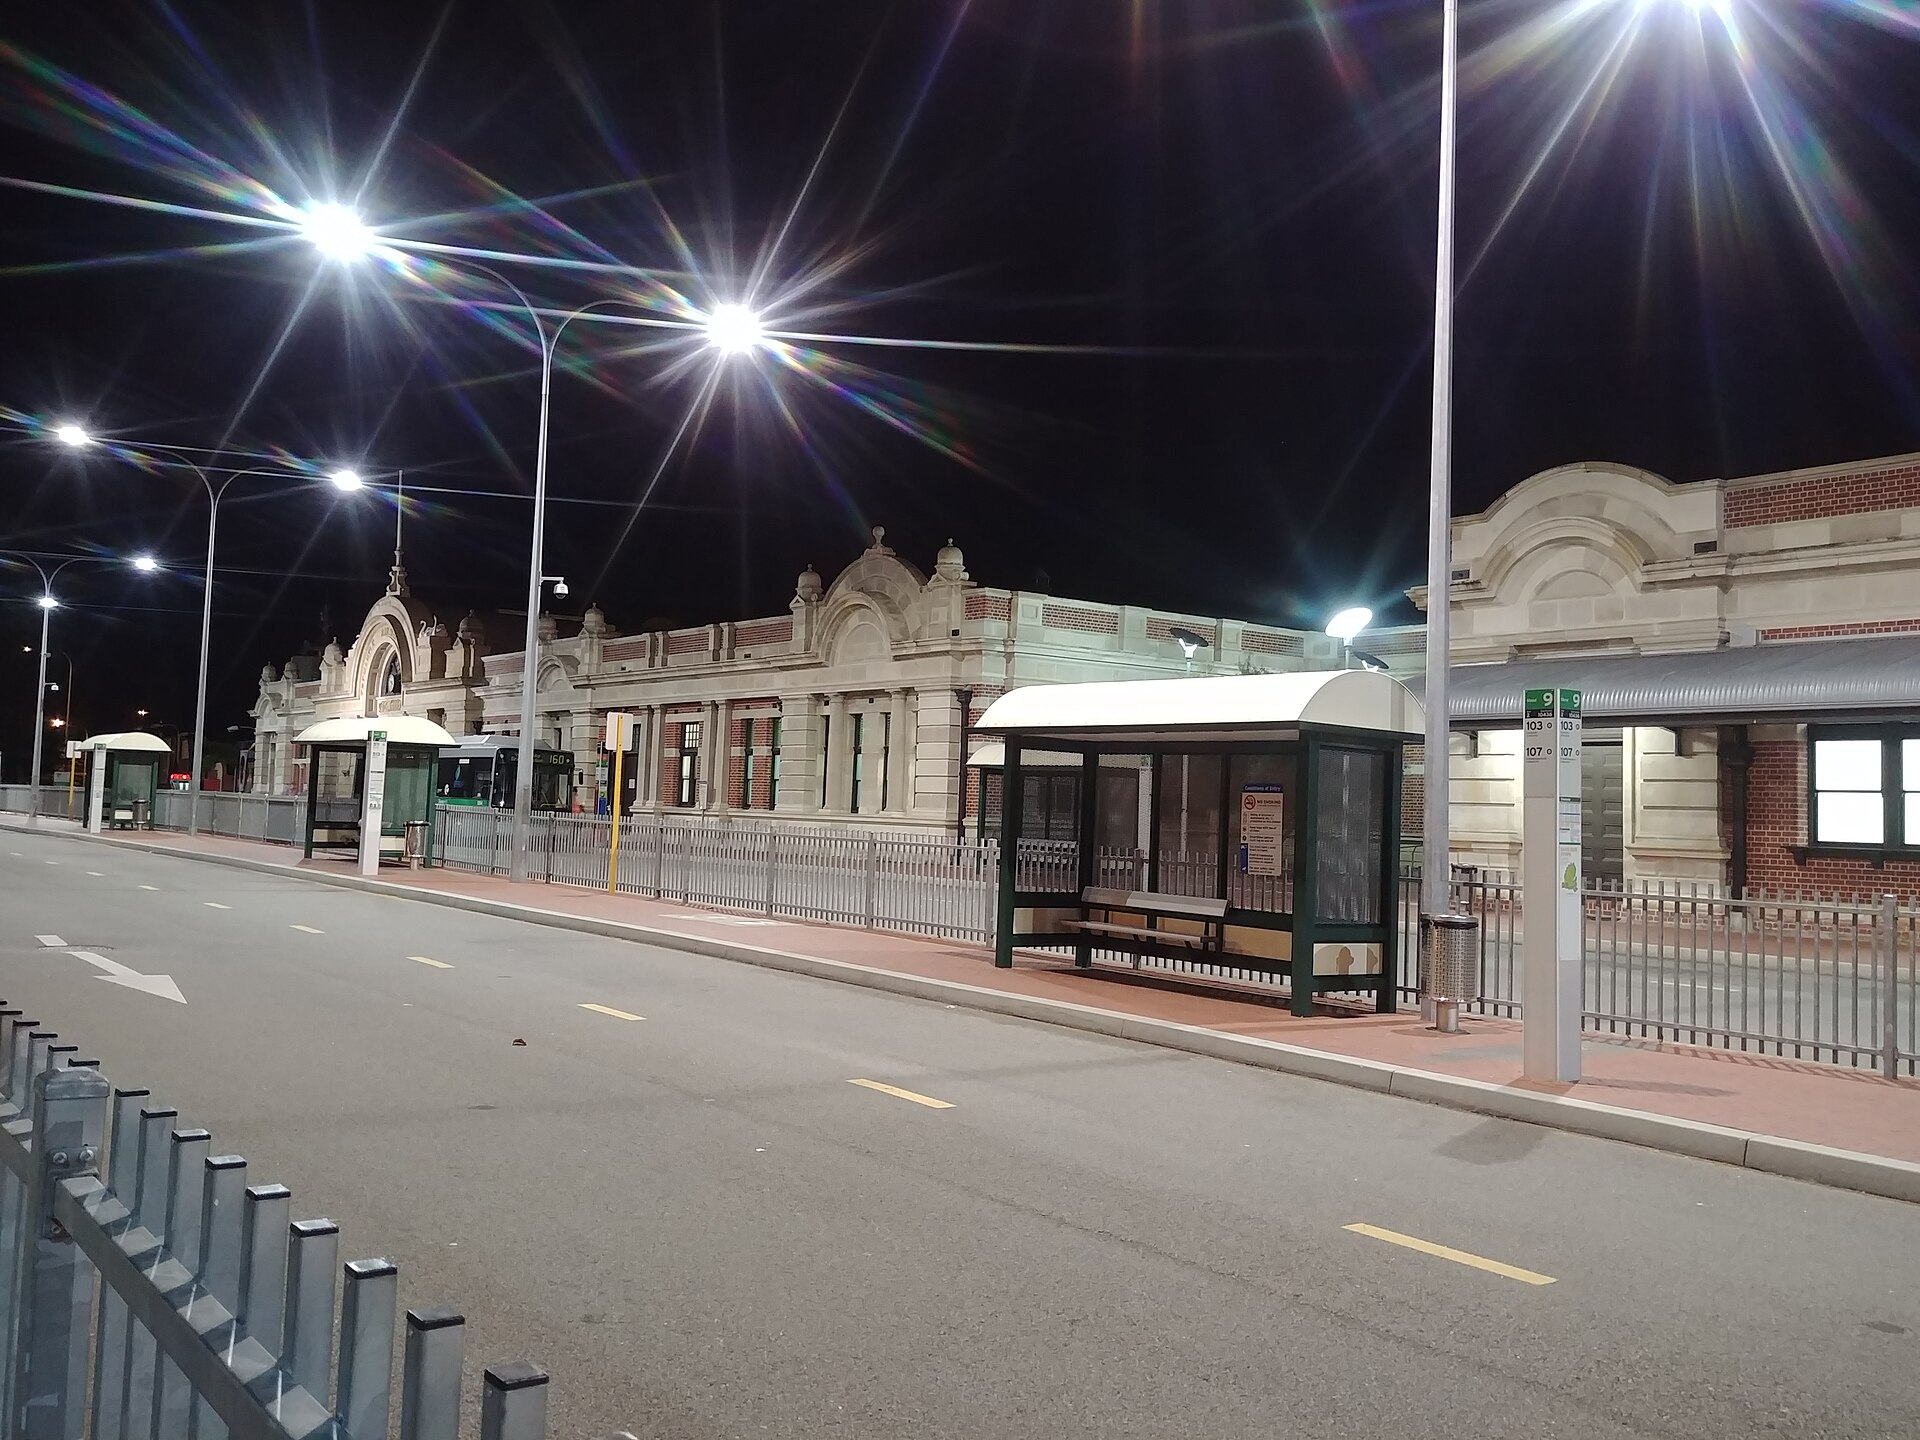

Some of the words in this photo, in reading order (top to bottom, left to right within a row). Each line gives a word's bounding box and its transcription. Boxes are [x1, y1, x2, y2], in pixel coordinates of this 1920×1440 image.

[1542, 692, 1553, 707] 9
[1572, 693, 1580, 708] 9
[1526, 721, 1543, 731] 103
[1560, 721, 1573, 731] 103
[1526, 747, 1543, 757] 107
[1560, 747, 1573, 757] 107
[549, 755, 565, 765] 160
